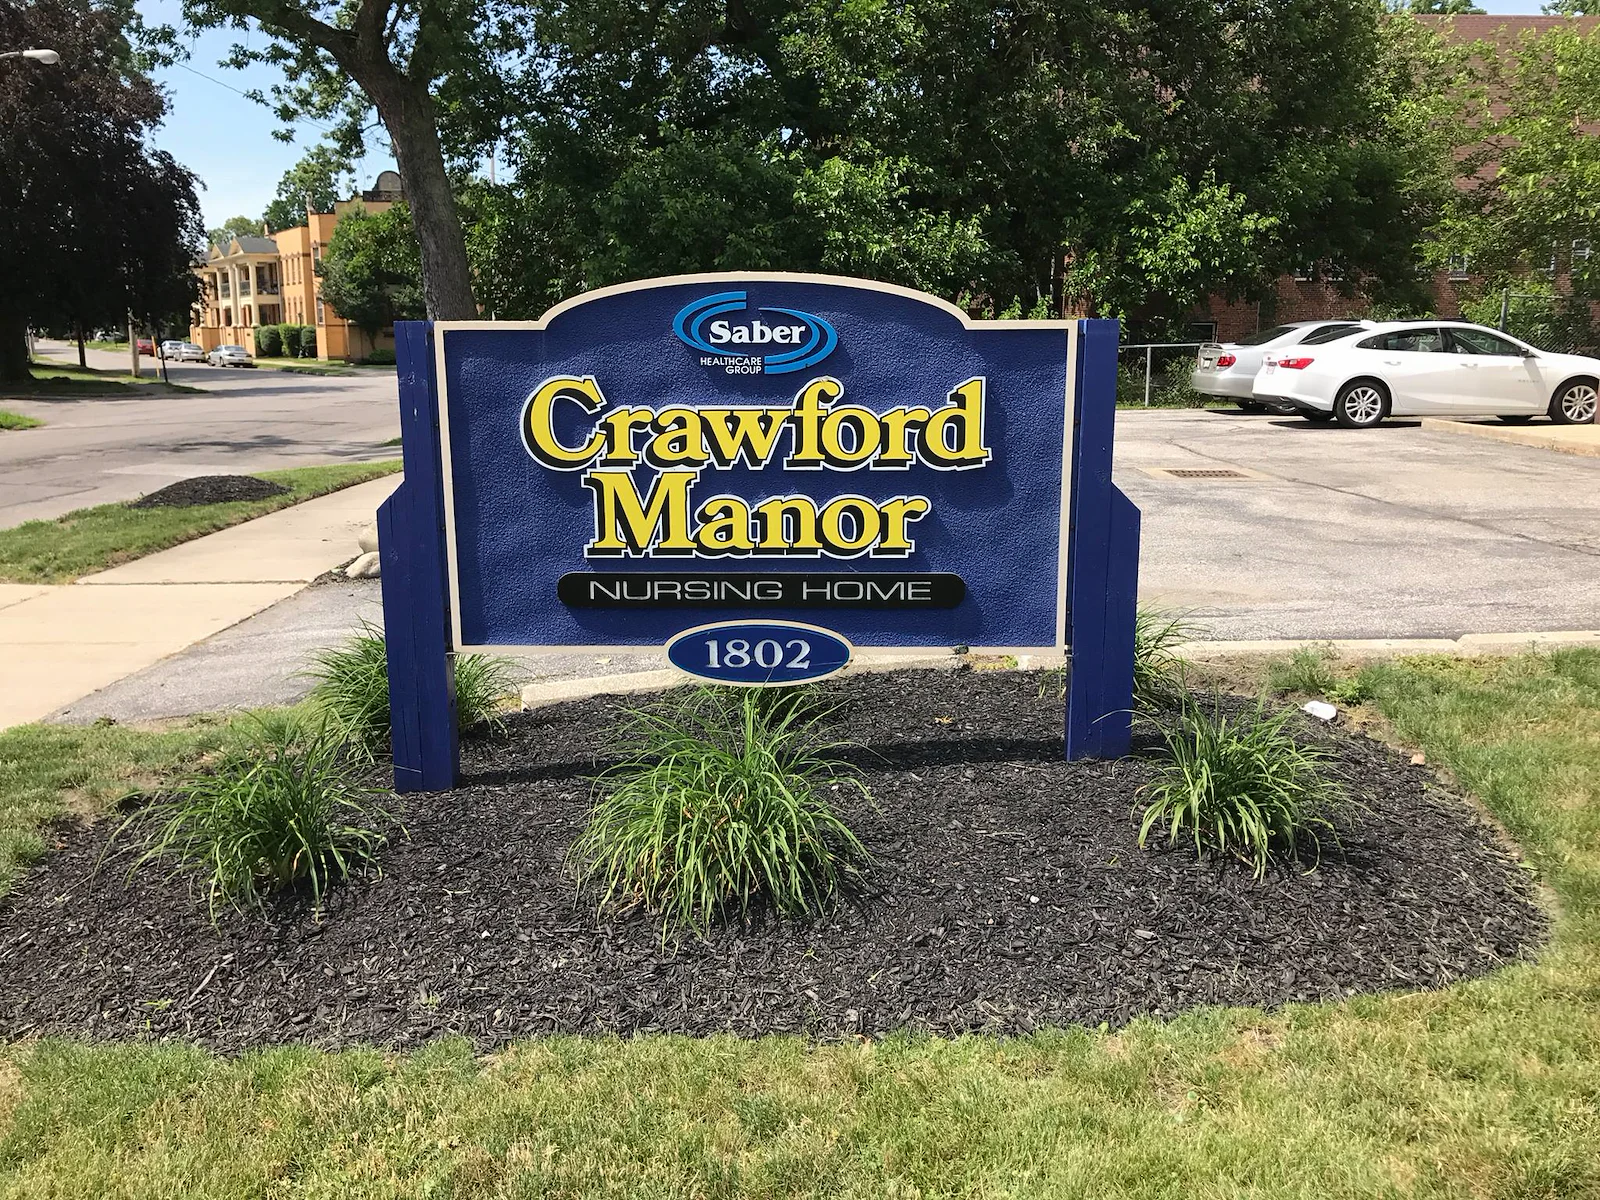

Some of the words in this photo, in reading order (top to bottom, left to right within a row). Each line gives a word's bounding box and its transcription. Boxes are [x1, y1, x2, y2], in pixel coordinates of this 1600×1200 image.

[709, 320, 806, 344] Saber
[700, 357, 762, 366] HEALTHCARE
[725, 365, 762, 375] GROUP
[519, 375, 992, 472] Crawford
[581, 469, 932, 559] Manor
[589, 580, 783, 601] NURSING
[802, 581, 932, 601] HOME
[705, 639, 811, 670] 1802
